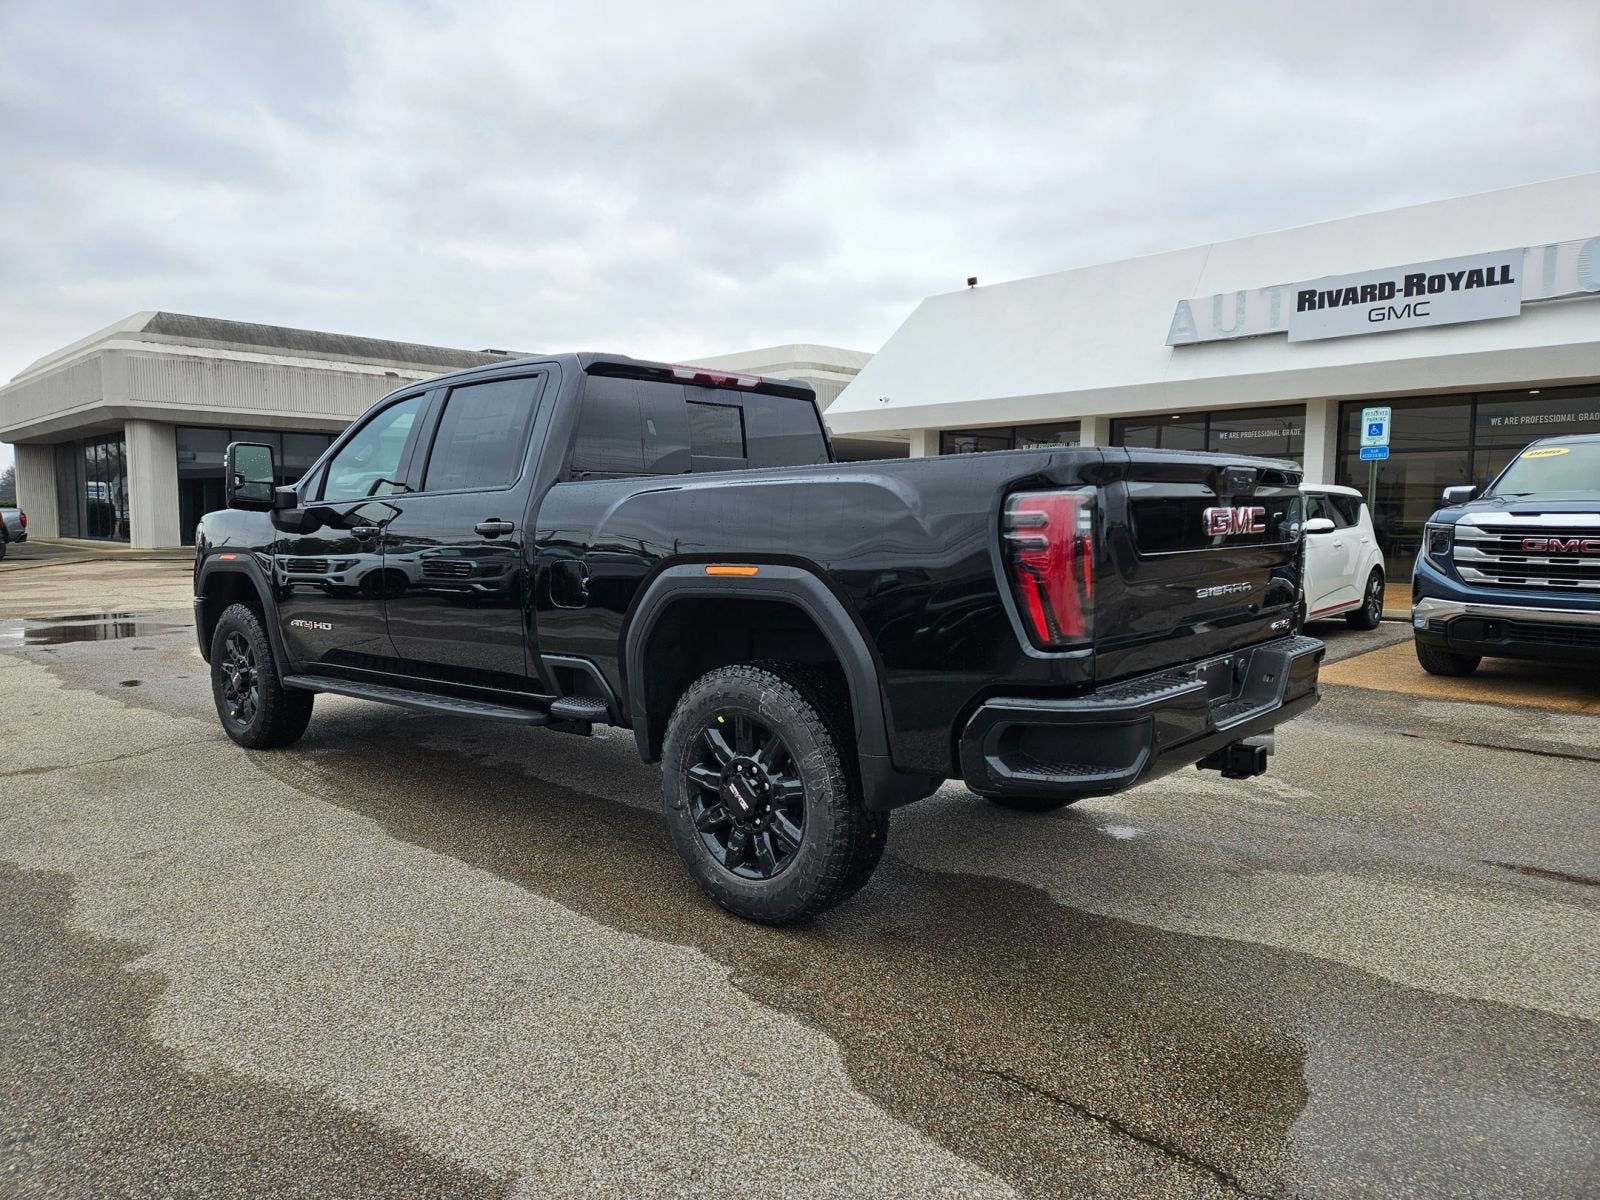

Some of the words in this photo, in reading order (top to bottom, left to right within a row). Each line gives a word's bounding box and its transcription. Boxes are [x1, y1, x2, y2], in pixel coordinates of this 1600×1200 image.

[1296, 264, 1515, 313] RIVARD-ROYALL
[1368, 301, 1430, 323] GMC
[1490, 417, 1502, 426] WE
[1504, 416, 1519, 425] ARE
[1520, 413, 1577, 425] PROFESSIONAL
[1219, 431, 1228, 440] WE
[1229, 431, 1240, 439] ARE
[1240, 429, 1281, 439] PROFESSIONAL
[1203, 506, 1265, 536] GMC
[1521, 538, 1600, 553] GMC
[1196, 581, 1252, 599] SIERRA
